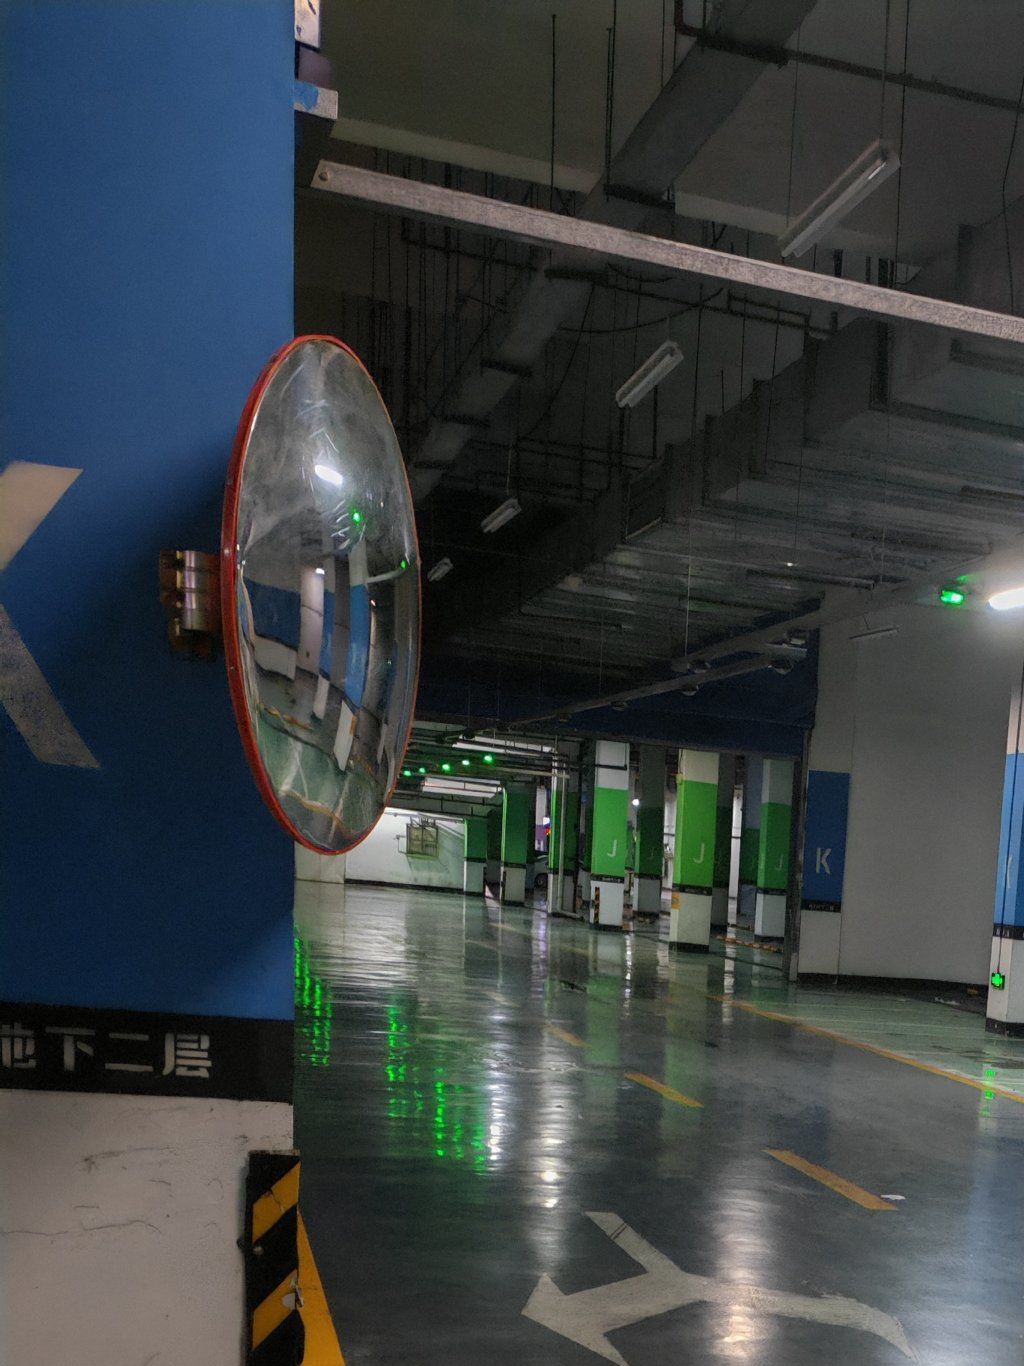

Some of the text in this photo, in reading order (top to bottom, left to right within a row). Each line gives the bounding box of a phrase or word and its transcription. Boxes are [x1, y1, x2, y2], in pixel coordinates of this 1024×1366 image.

[607, 840, 618, 858] J
[693, 843, 705, 864] J
[815, 847, 832, 875] K
[0, 1022, 212, 1079] 地下二层
